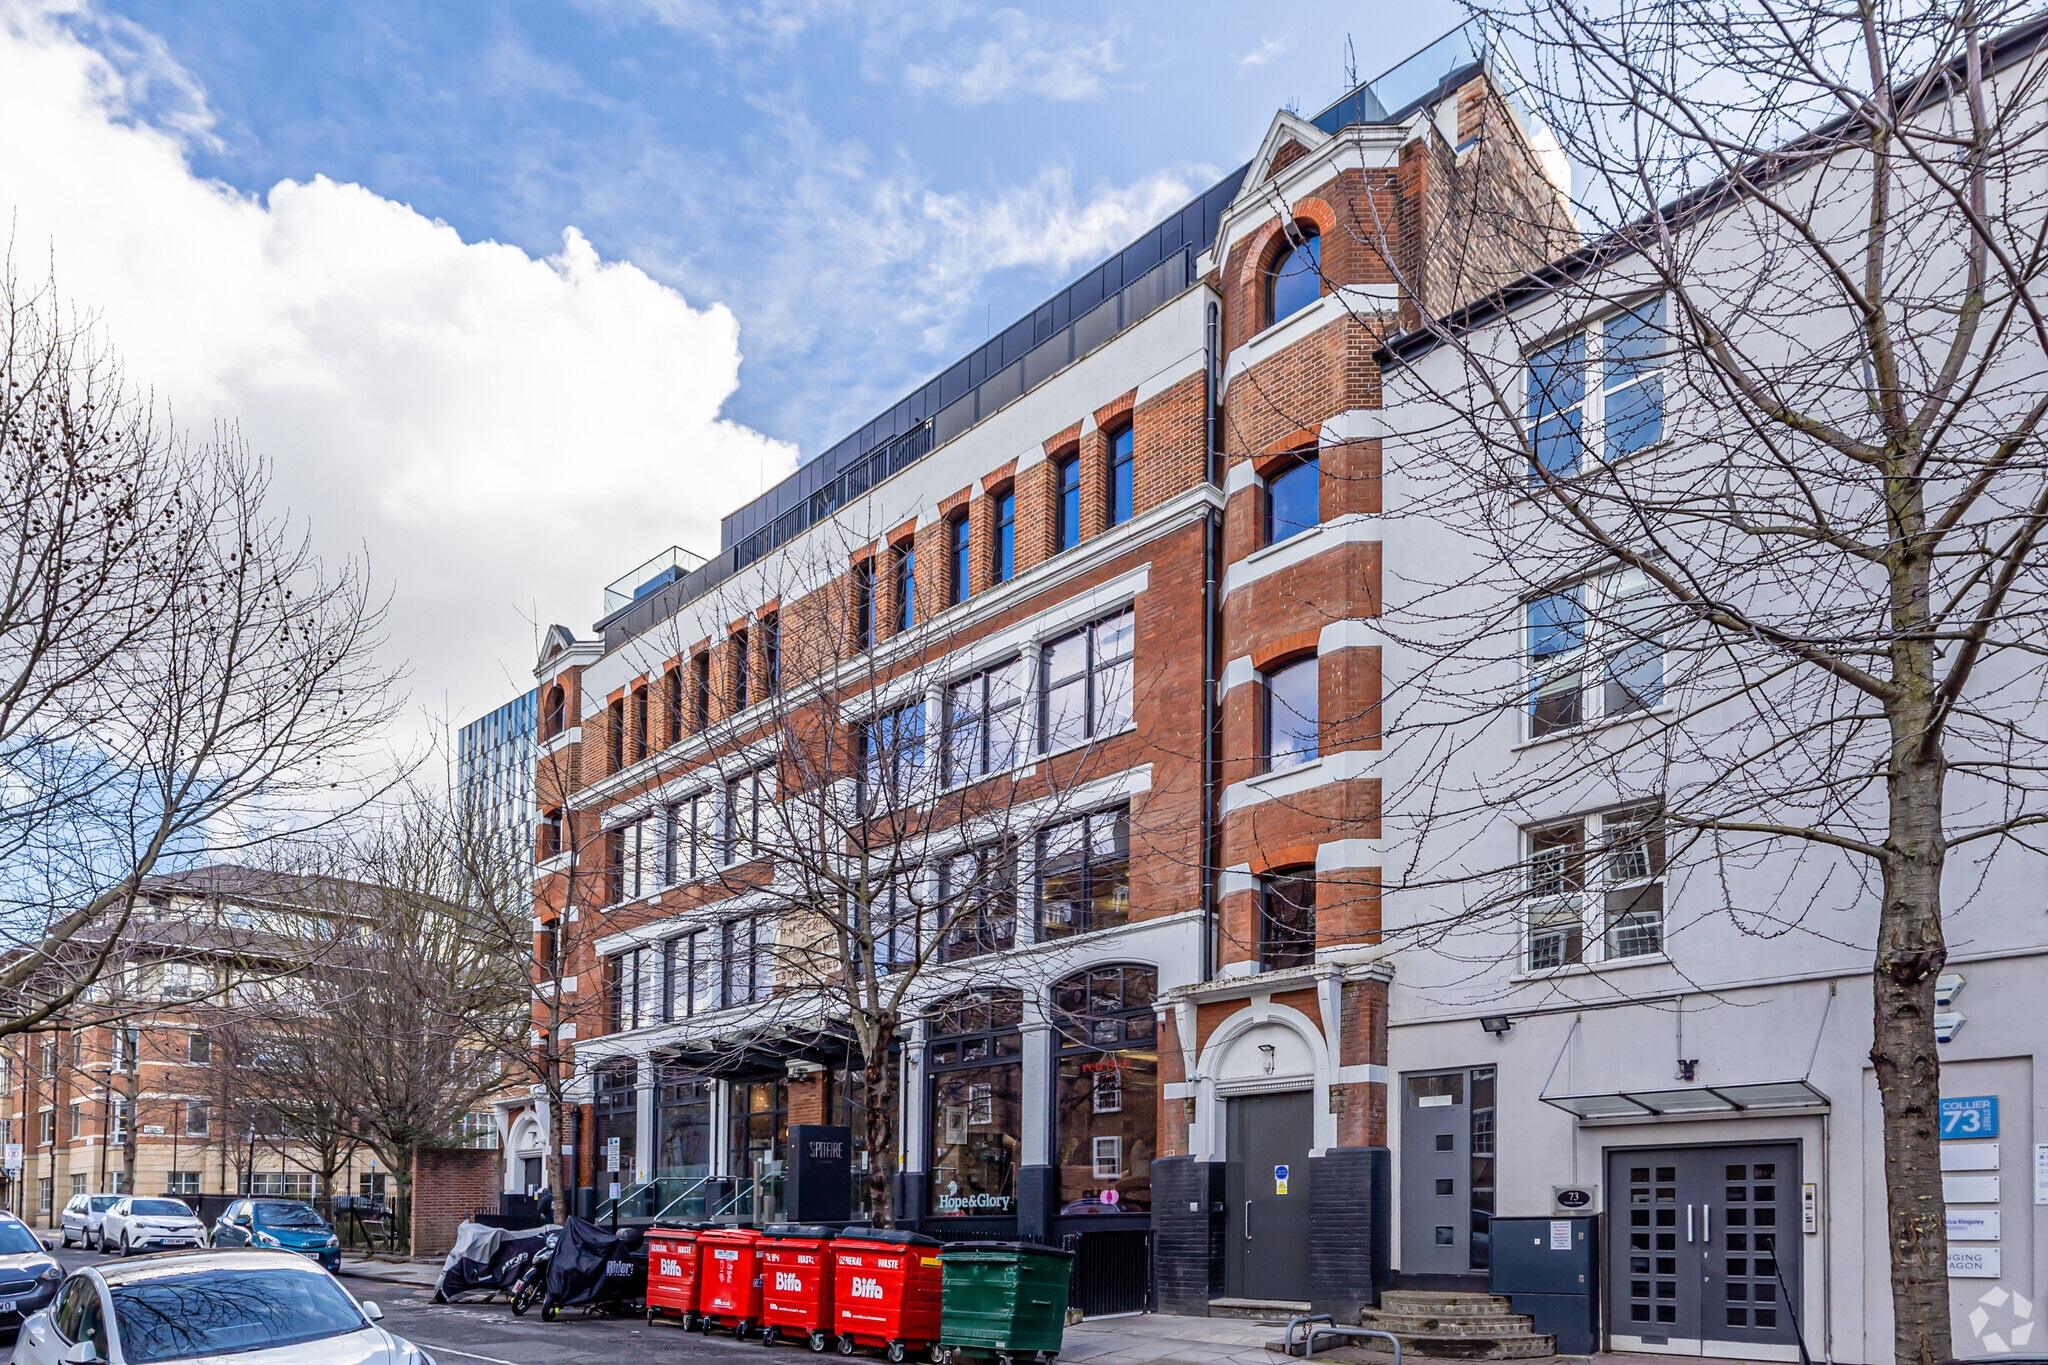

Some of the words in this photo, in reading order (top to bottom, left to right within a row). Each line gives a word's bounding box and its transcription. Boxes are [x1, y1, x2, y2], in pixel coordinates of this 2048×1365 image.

[1942, 1100, 1991, 1111] COLLIER
[1942, 1109, 1981, 1133] 73
[1983, 1108, 1992, 1132] STREET
[809, 1141, 843, 1159] SPITFIRE
[939, 1193, 1011, 1212] Hope&Glory
[1568, 1192, 1580, 1201] 73
[677, 1245, 692, 1255] WASTE
[660, 1258, 682, 1277] Biffa
[838, 1255, 862, 1267] GENERAL
[877, 1258, 899, 1270] WASTE
[775, 1271, 802, 1292] Biffa
[851, 1276, 883, 1300] Biffa
